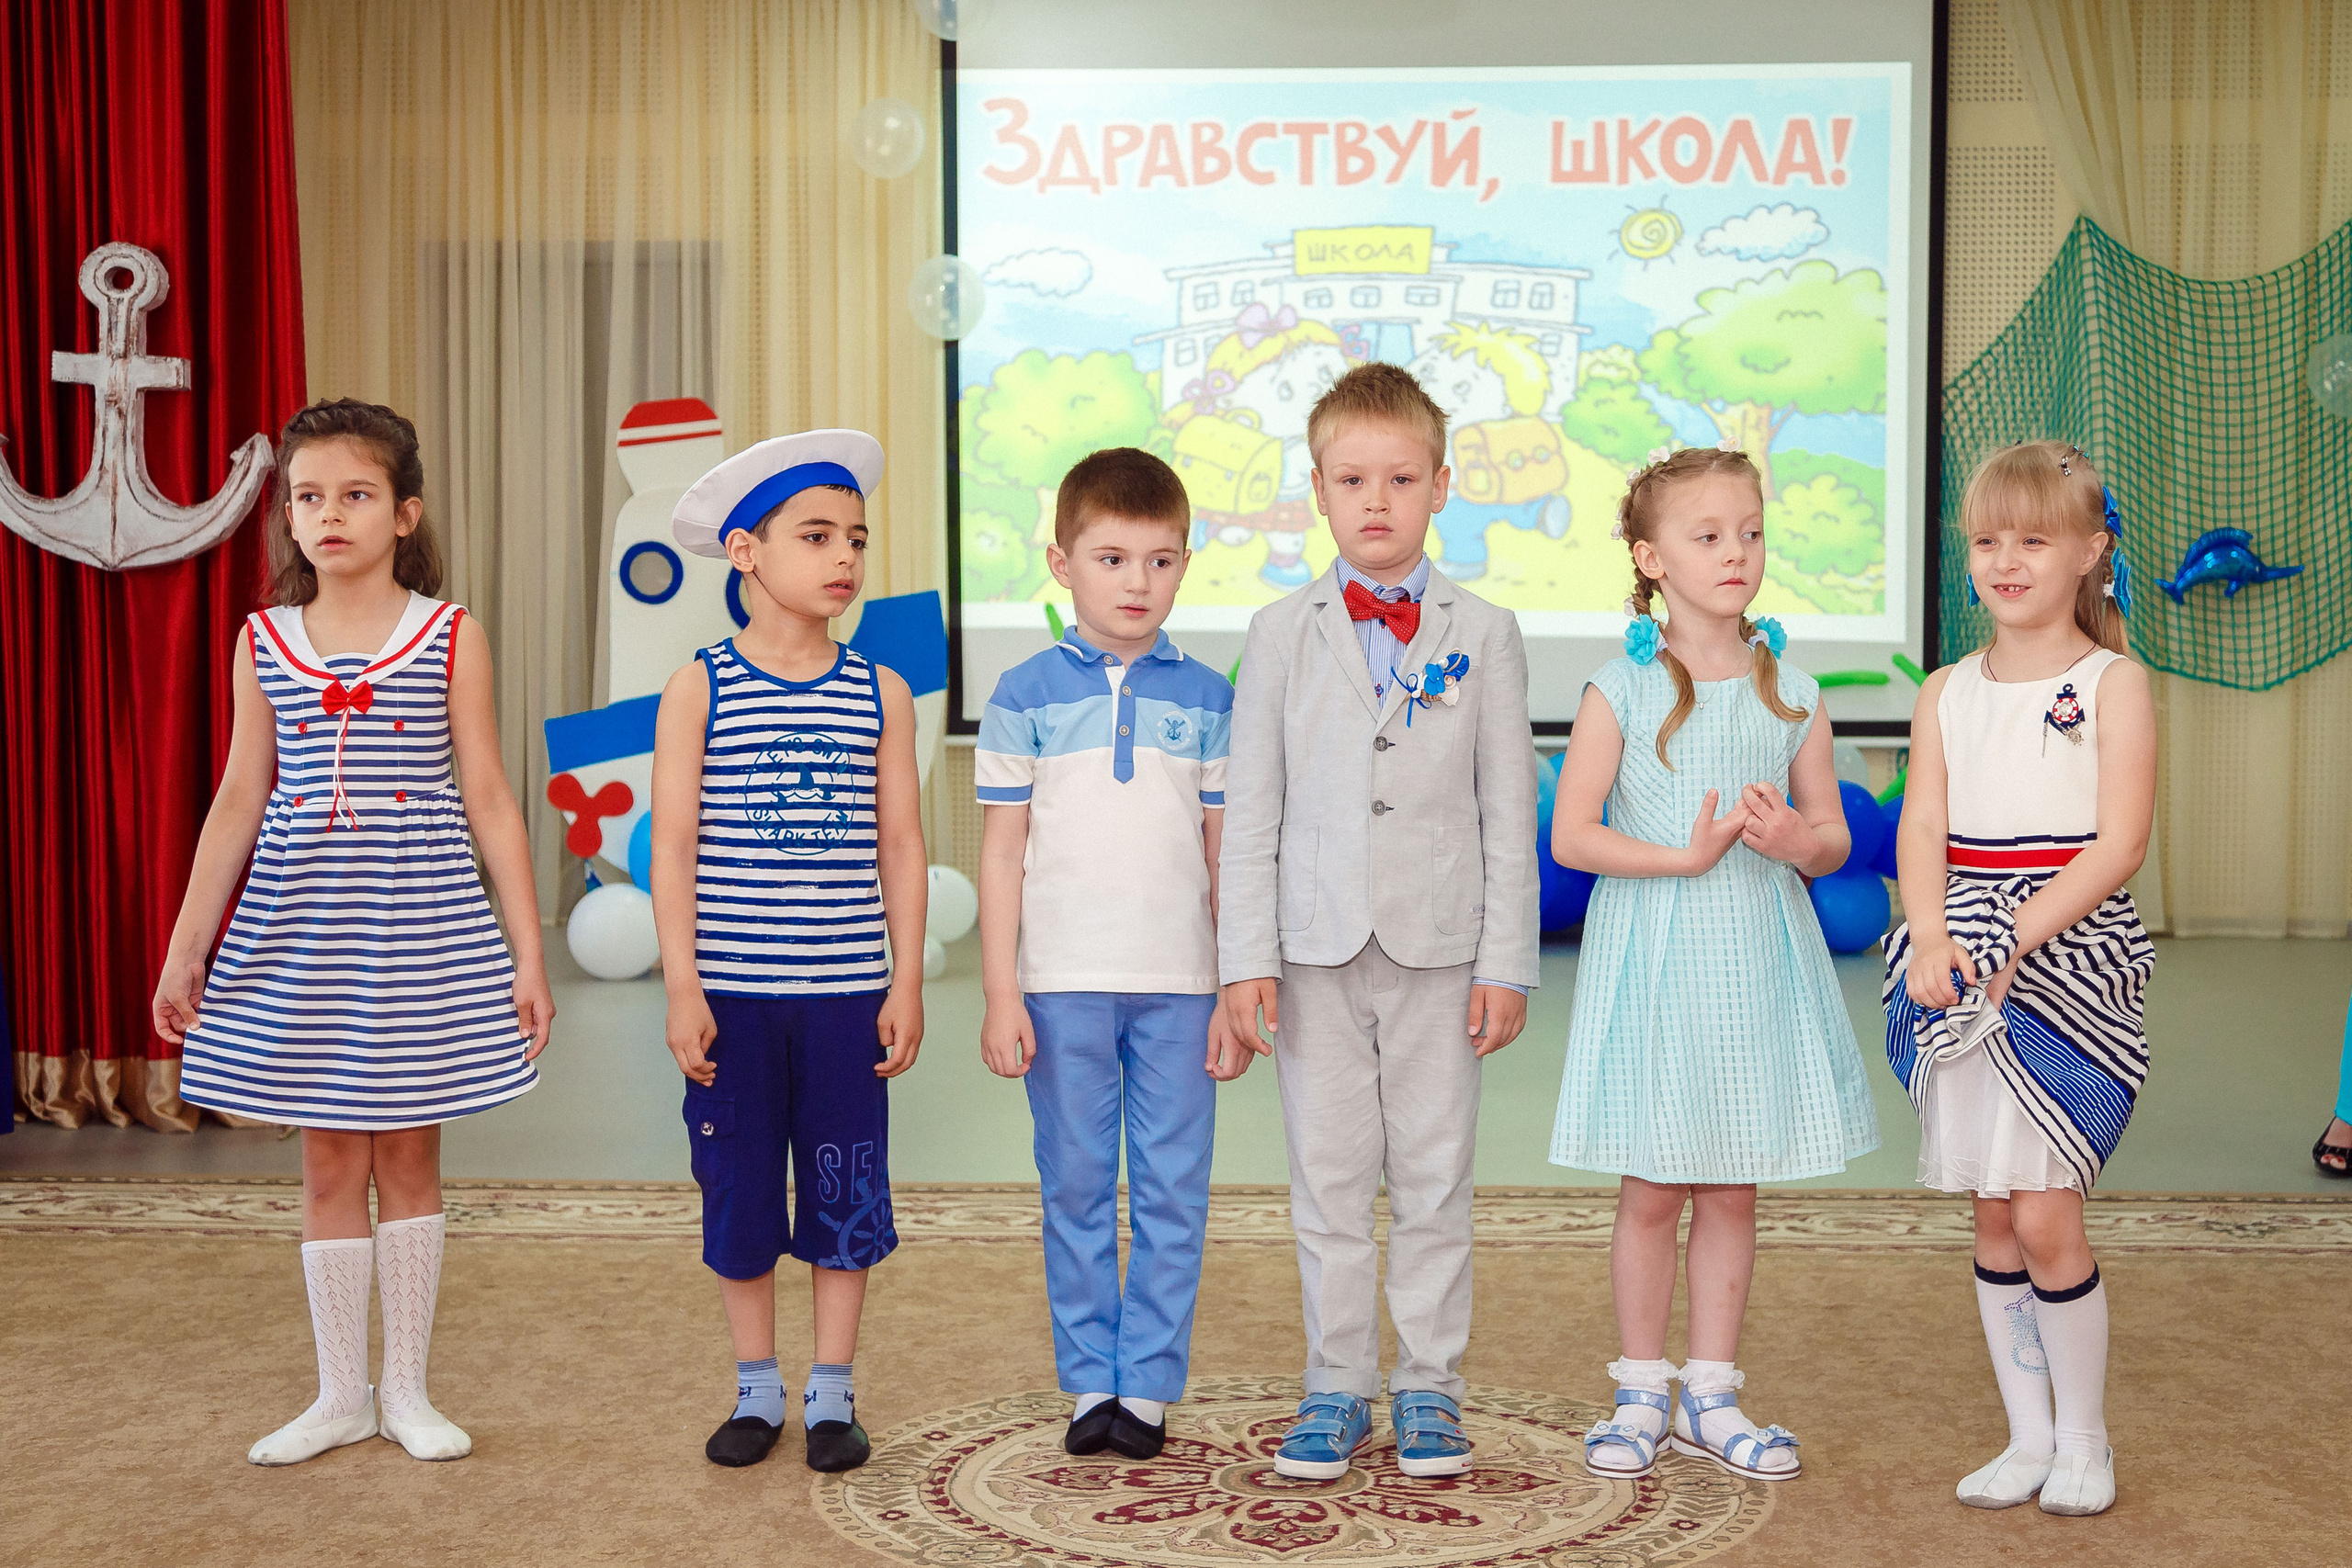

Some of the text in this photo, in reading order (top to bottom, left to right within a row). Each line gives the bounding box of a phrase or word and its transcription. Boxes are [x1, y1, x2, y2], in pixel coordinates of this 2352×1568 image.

[982, 97, 1852, 202] ЗДРАВСТВУЙ, ШКОЛА!
[1307, 243, 1416, 263] ШКОЛА
[752, 807, 849, 848] SHARK TEAM
